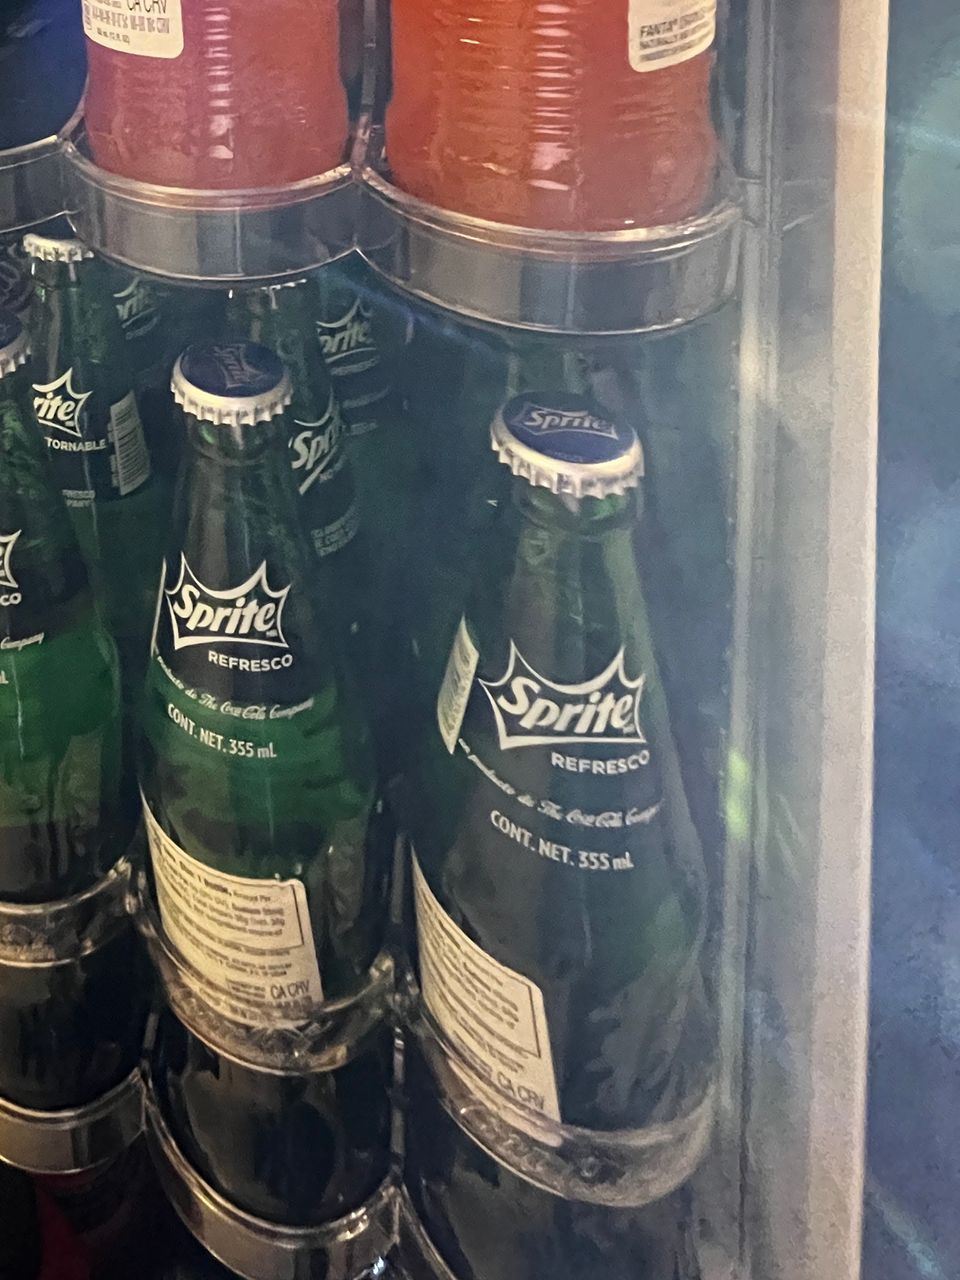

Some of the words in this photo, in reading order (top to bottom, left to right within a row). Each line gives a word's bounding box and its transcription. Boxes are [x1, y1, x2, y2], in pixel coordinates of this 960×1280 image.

[33, 392, 75, 422] rite
[524, 410, 612, 431] Sprite
[44, 436, 108, 452] TORNABLE
[173, 583, 277, 636] Sprite
[207, 649, 294, 673] REFRESCO
[496, 675, 635, 734] Sprite
[167, 702, 198, 739] CONT.
[199, 726, 228, 754] NET.
[228, 737, 255, 759] 355
[257, 741, 278, 759] mL
[550, 749, 651, 776] REFRESCO
[490, 809, 536, 852] CONT.
[538, 837, 576, 868] NET.
[578, 850, 611, 871] 355
[612, 850, 636, 873] mL
[270, 984, 286, 1000] CA
[496, 1070, 518, 1099] CA
